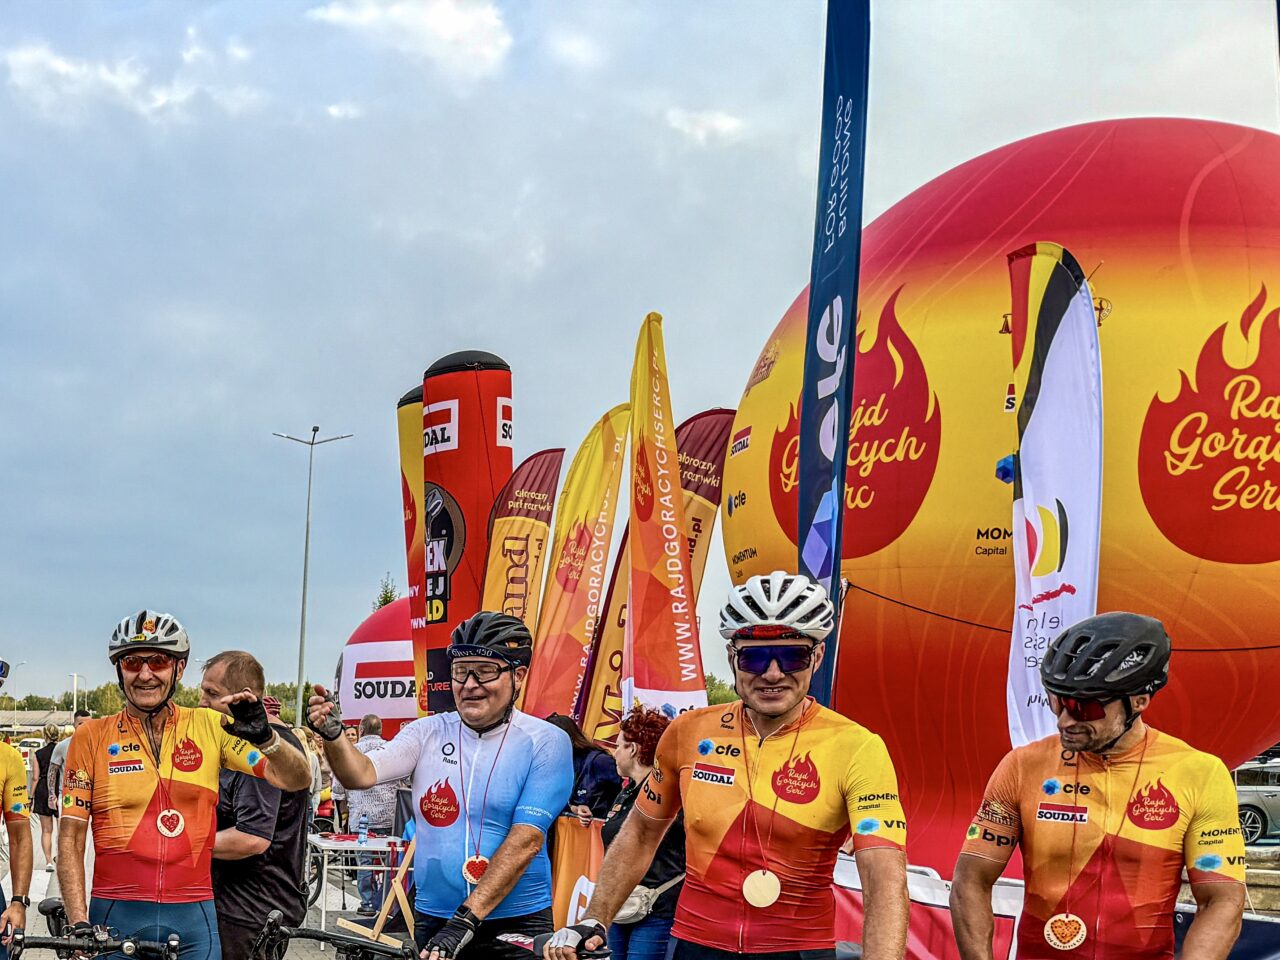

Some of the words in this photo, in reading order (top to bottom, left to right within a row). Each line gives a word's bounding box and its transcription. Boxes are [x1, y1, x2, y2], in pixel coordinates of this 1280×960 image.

[975, 544, 1007, 556] Capital
[354, 680, 417, 700] SOUDA
[121, 742, 141, 753] cfe
[715, 743, 741, 757] cfe
[442, 756, 458, 766] Raso
[109, 763, 144, 774] SOUDAL
[787, 768, 809, 780] Rajd
[692, 769, 733, 785] SOUDAL
[642, 780, 663, 805] bpi
[785, 785, 806, 796] Serc
[1063, 782, 1091, 795] cfe
[75, 795, 91, 810] bp
[430, 793, 449, 804] Rajd
[1142, 796, 1166, 809] Rajd
[430, 810, 447, 819] Serc
[1037, 810, 1087, 823] SOUDAL
[1143, 814, 1165, 822] Serc
[982, 828, 1016, 847] bpi
